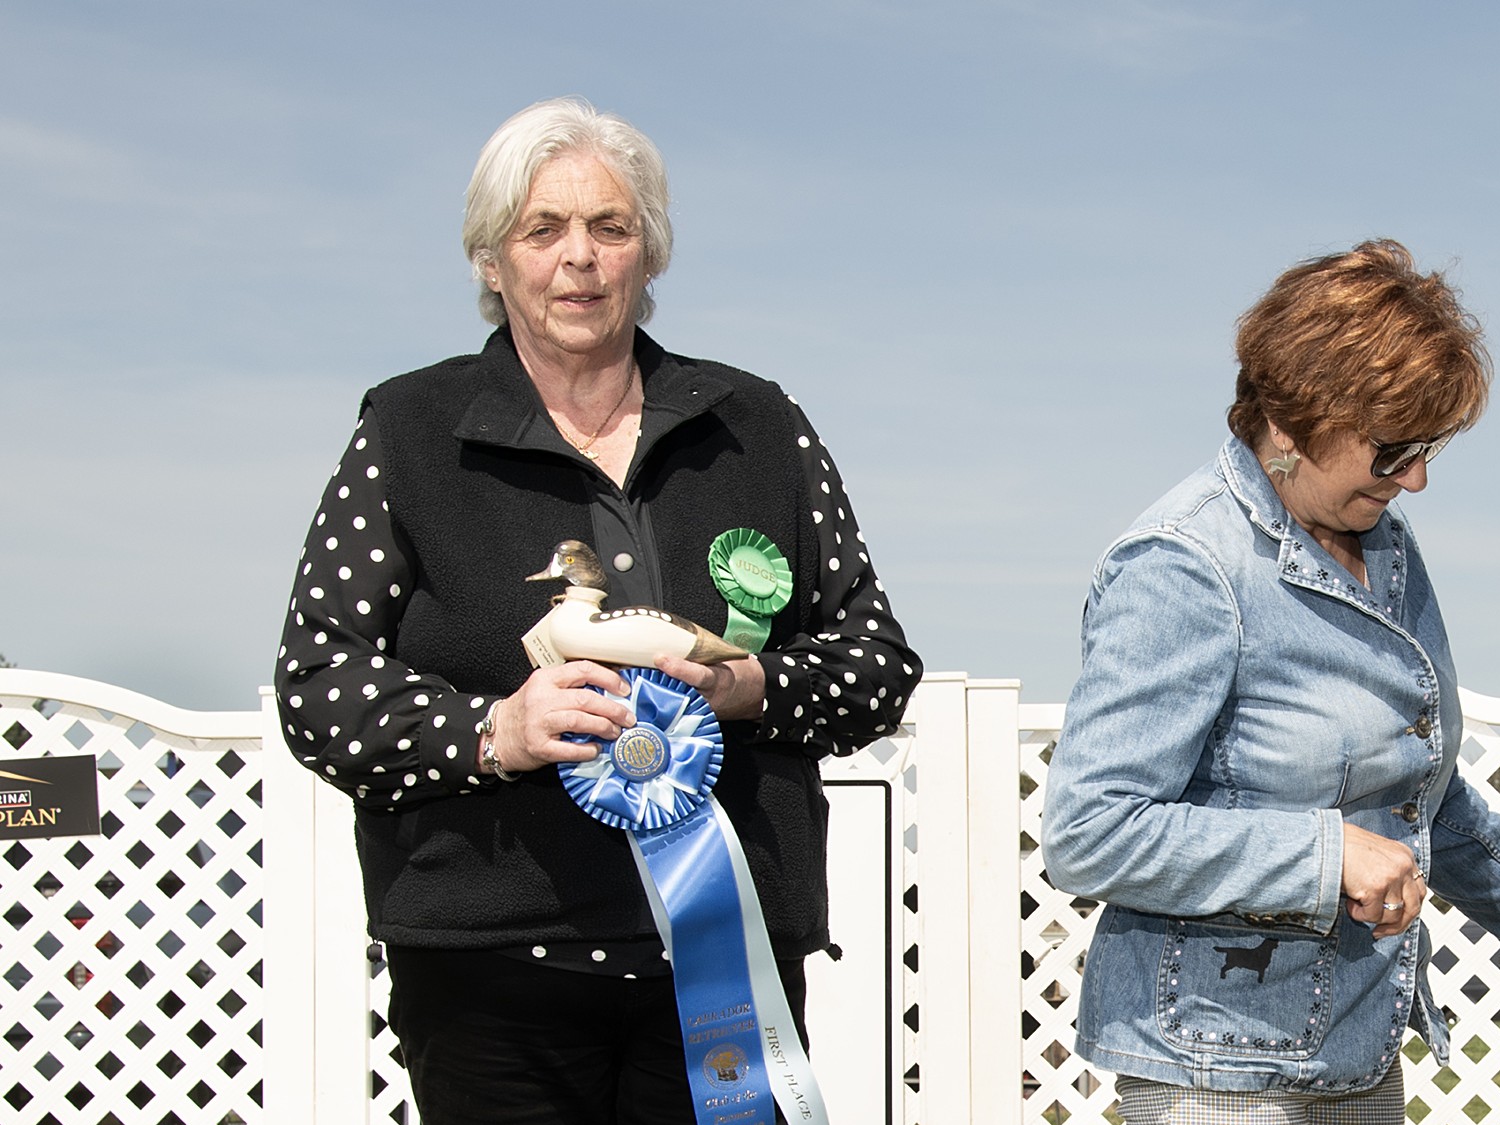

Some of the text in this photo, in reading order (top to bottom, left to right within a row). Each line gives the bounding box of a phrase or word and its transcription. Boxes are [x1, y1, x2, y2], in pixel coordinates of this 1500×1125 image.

[735, 559, 776, 583] JUDGE
[765, 1026, 812, 1120] FIRST PLACE
